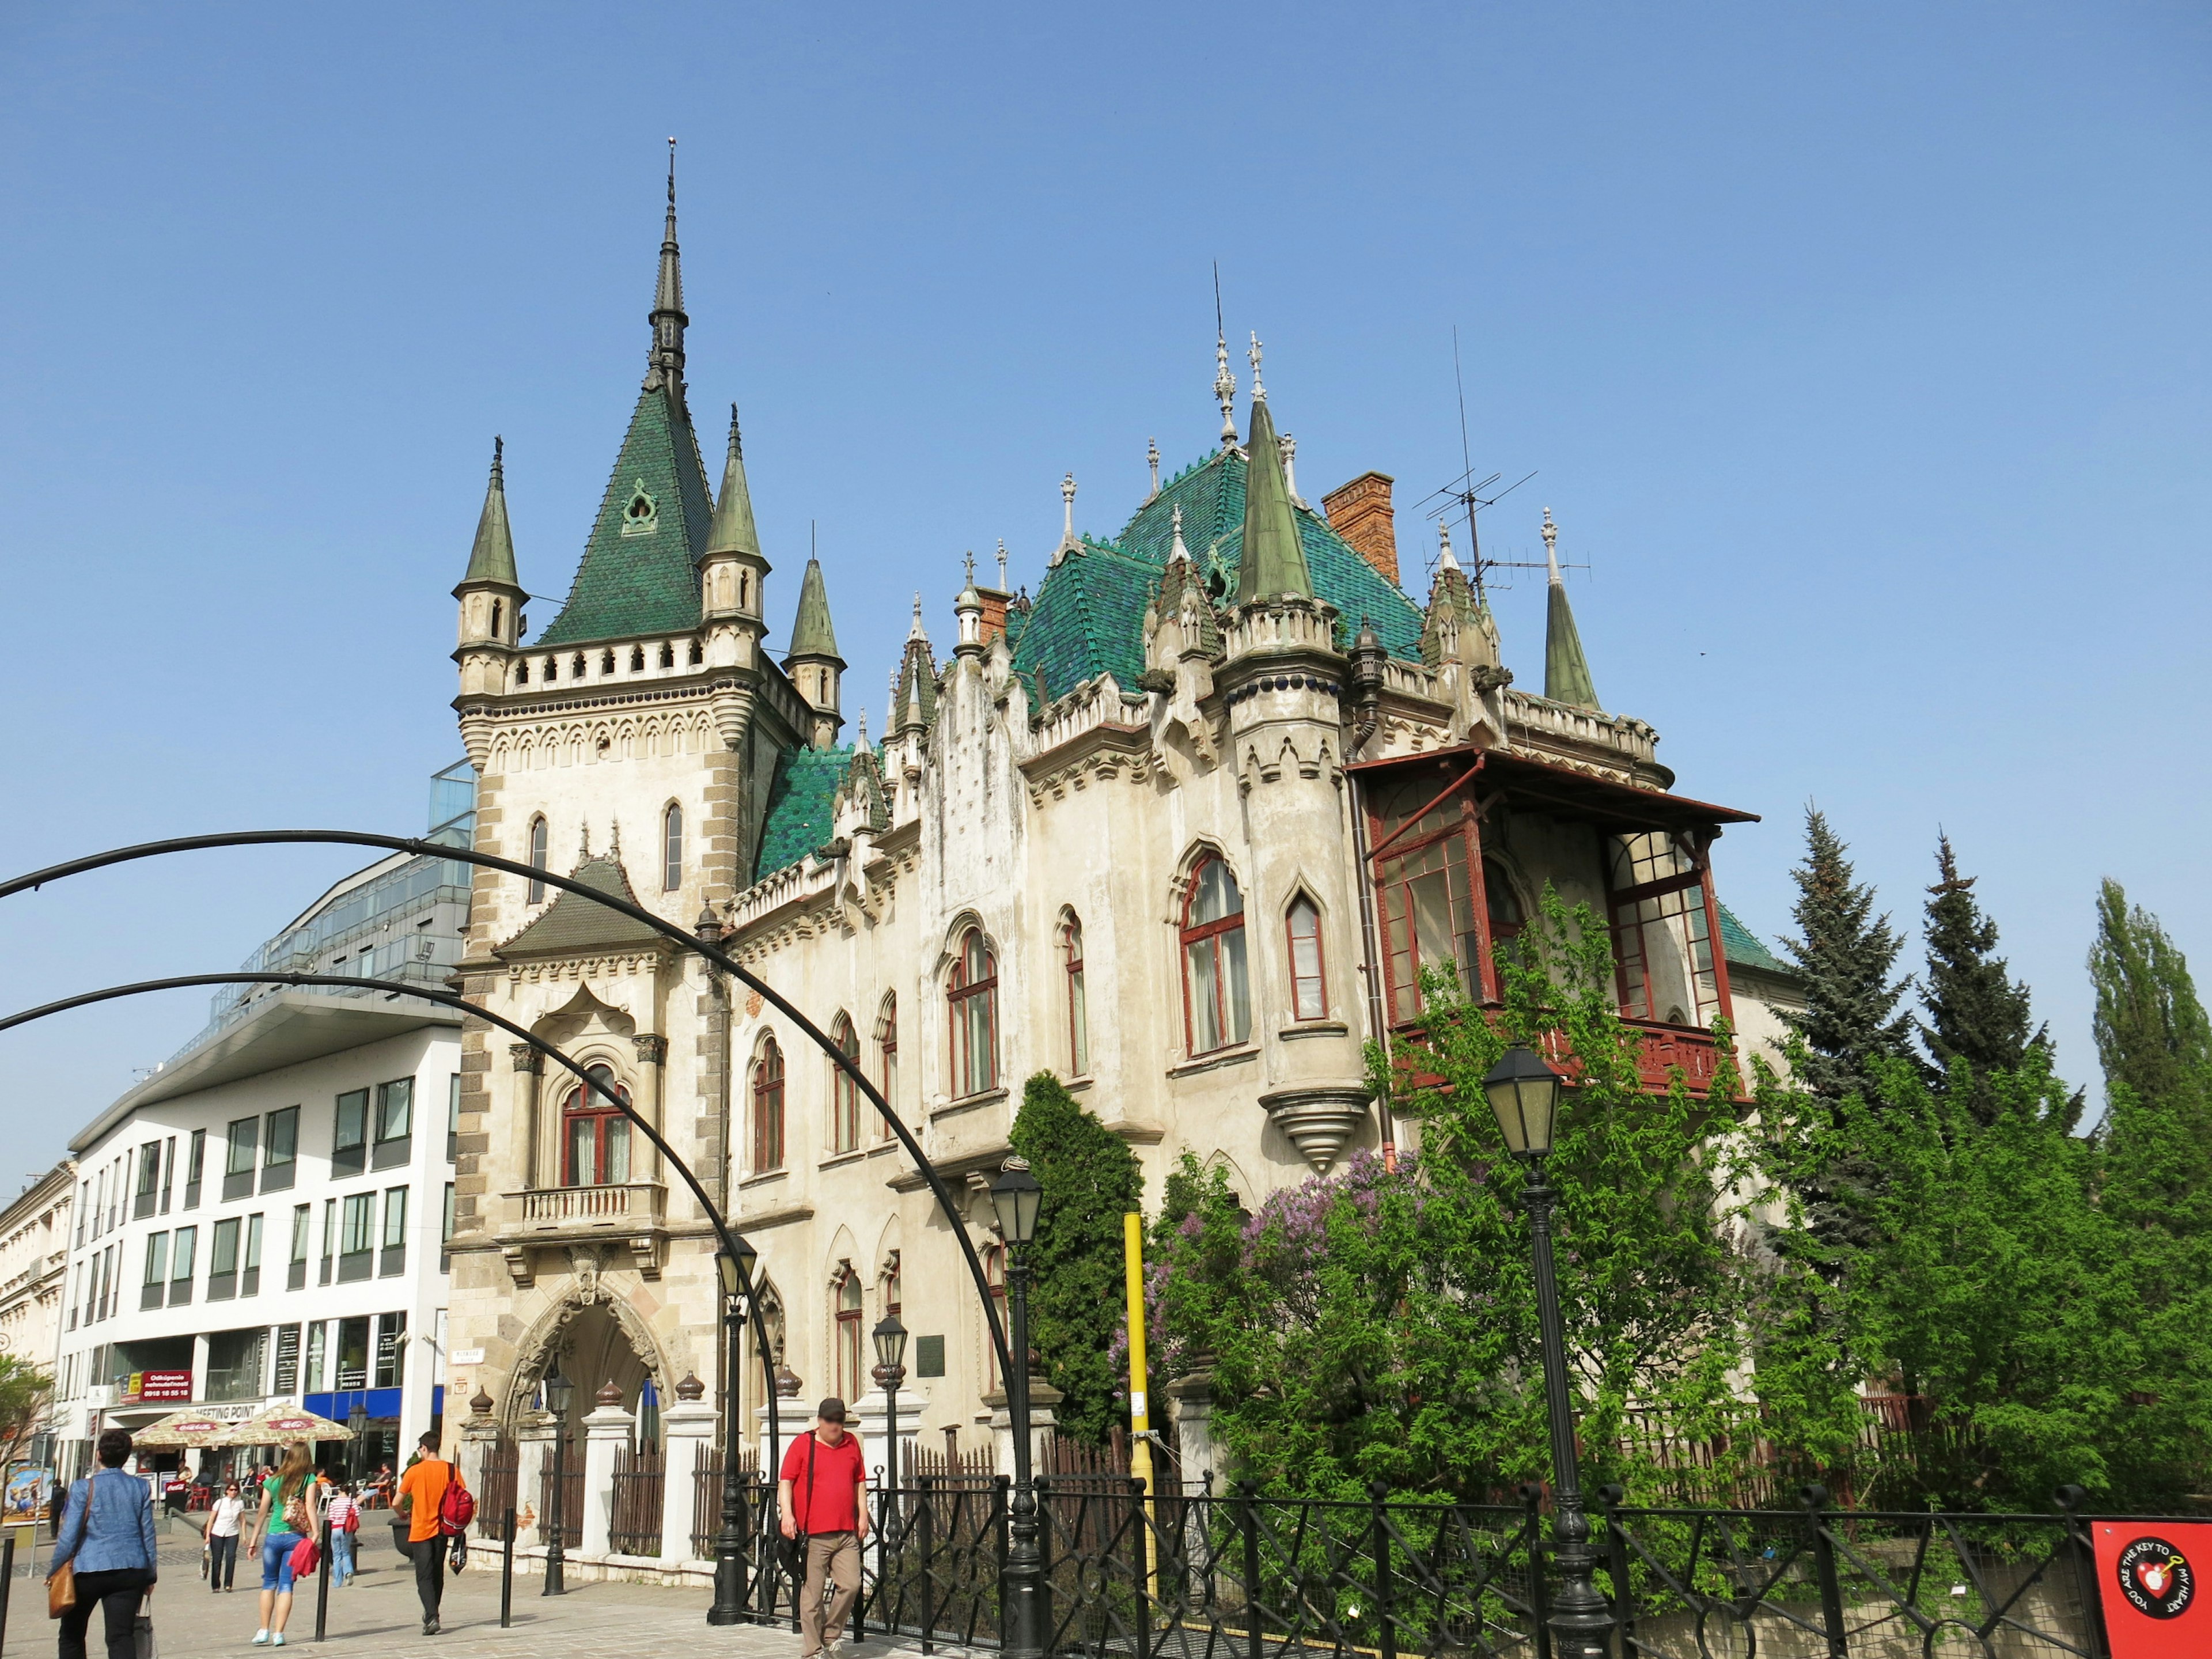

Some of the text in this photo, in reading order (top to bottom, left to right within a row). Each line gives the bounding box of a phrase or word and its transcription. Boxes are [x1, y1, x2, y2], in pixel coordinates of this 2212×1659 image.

[232, 1405, 255, 1418] POINT
[2121, 1543, 2190, 1613] YOU ARE THE KEY TO MY HEART
